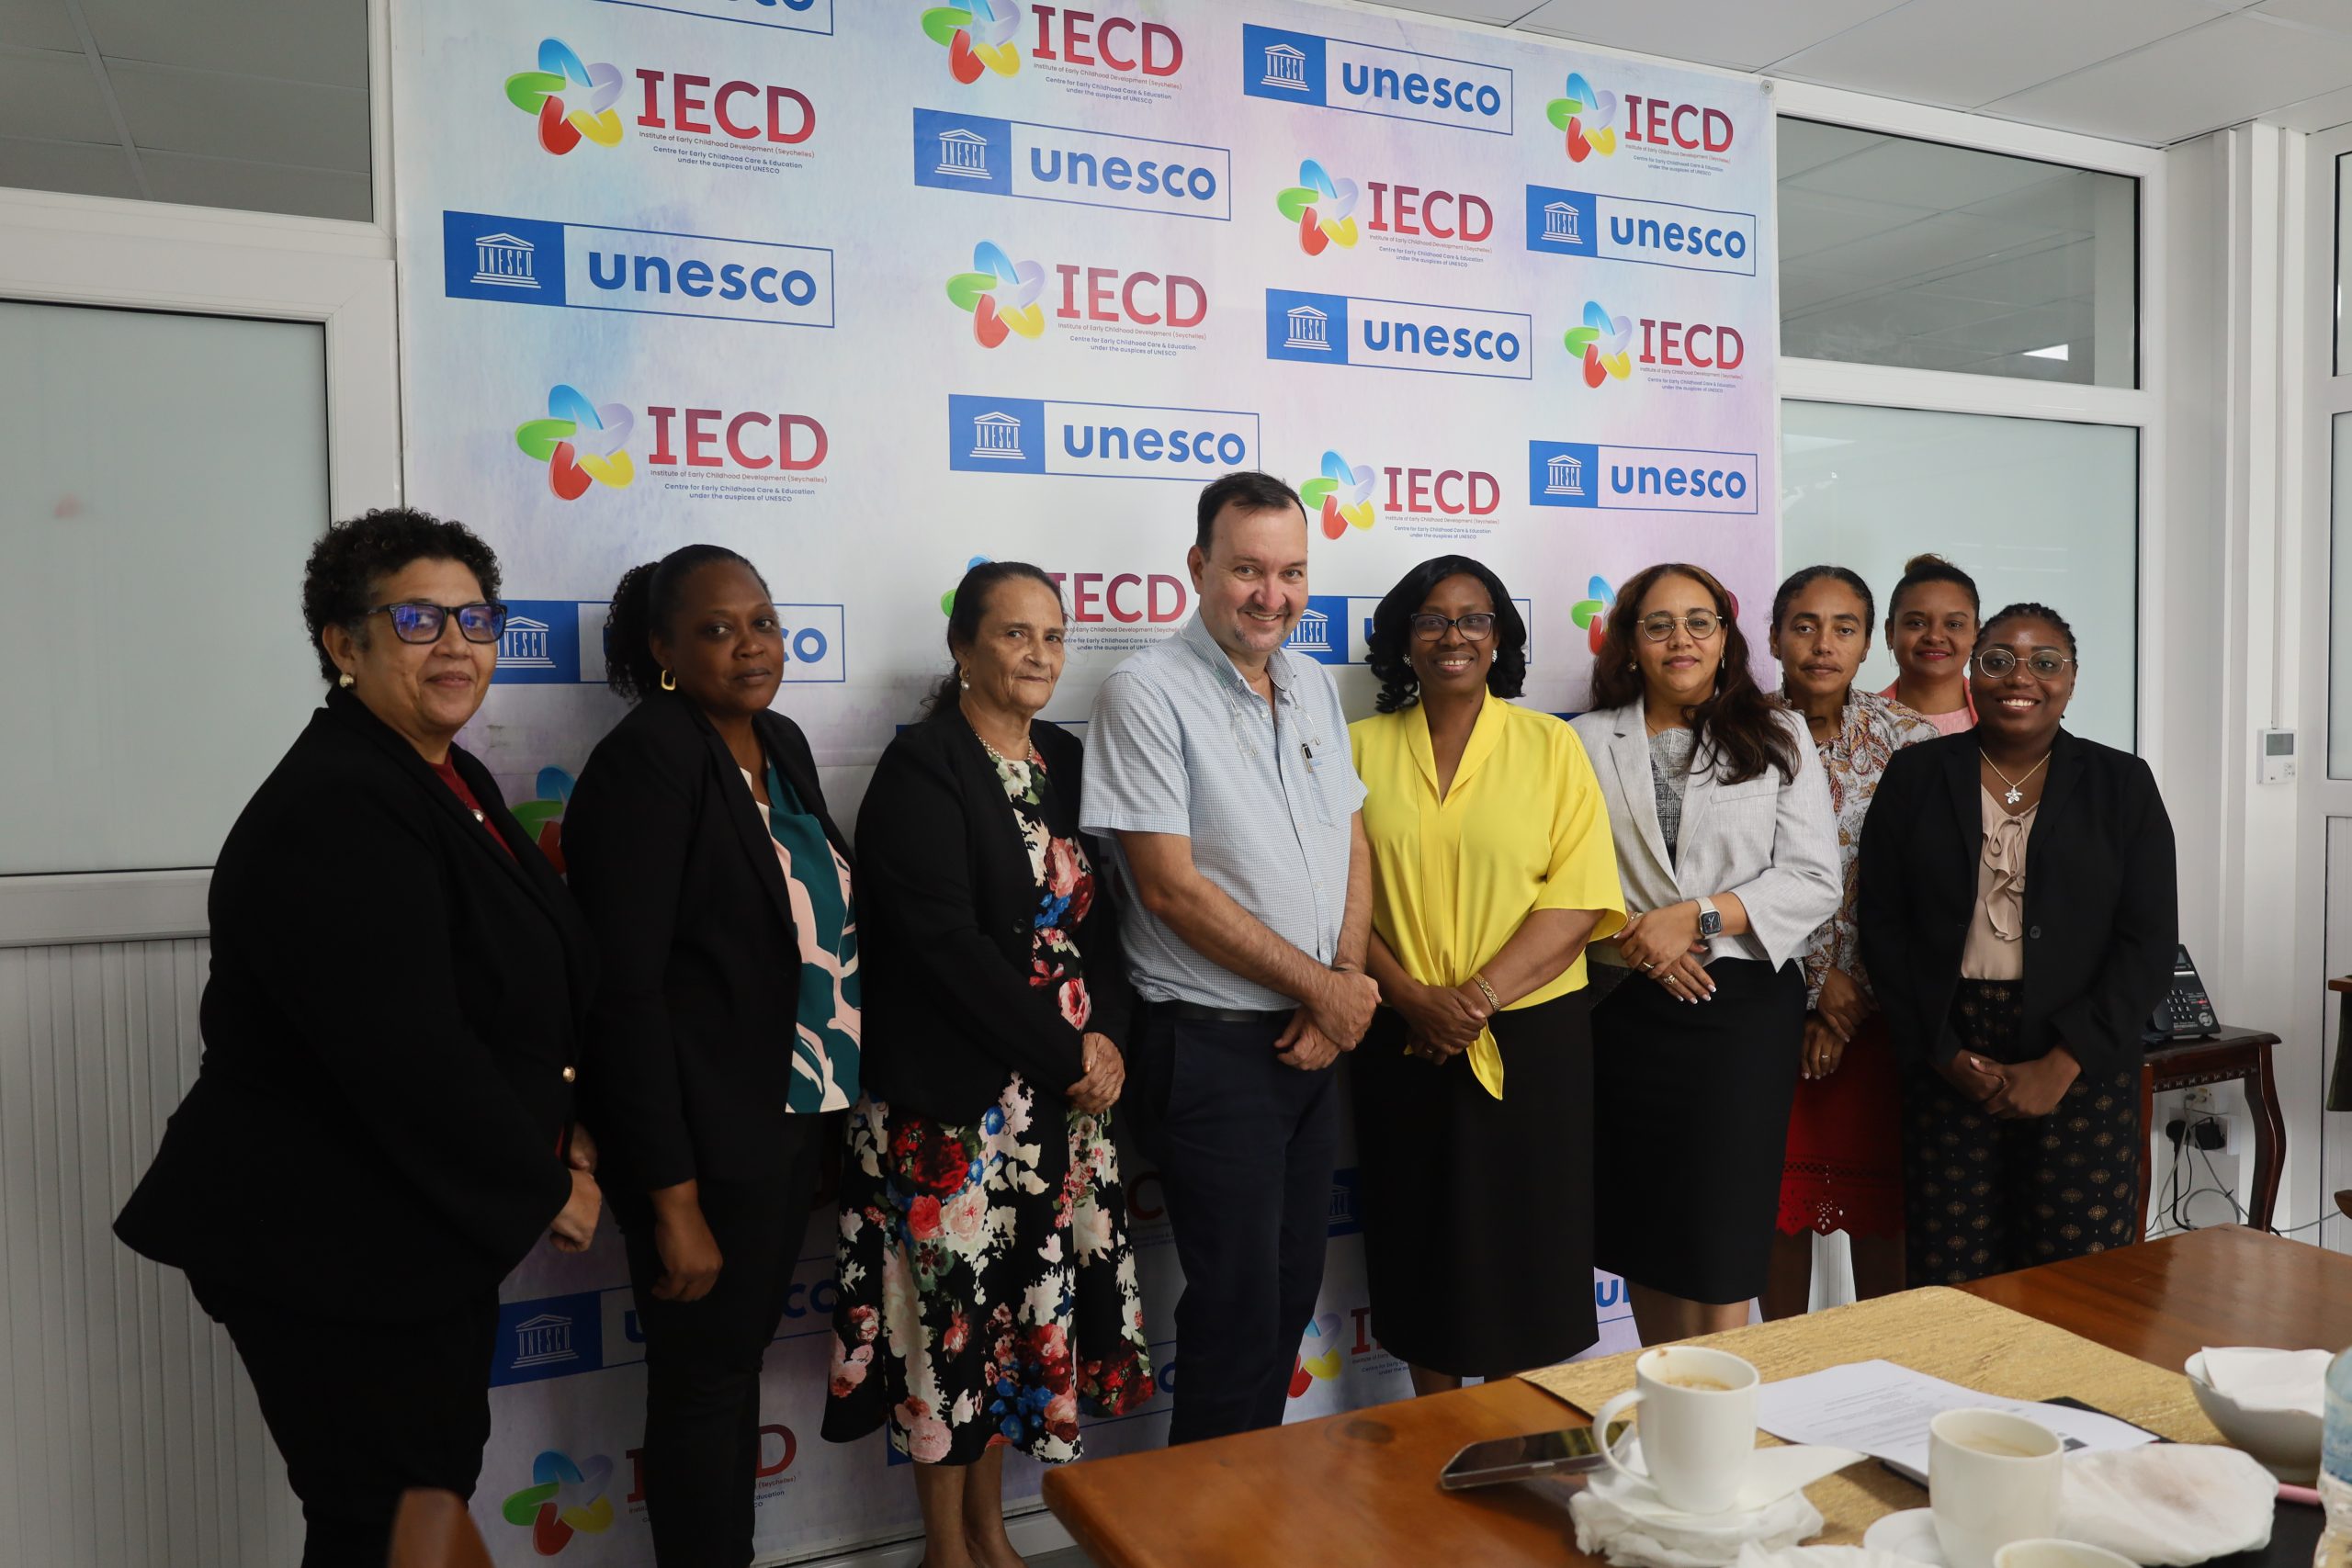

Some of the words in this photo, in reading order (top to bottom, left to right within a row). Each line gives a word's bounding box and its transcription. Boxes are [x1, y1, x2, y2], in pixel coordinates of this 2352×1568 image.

[1032, 4, 1183, 76] IECD
[1080, 70, 1109, 79] Childhood
[1110, 74, 1147, 85] Development
[1267, 54, 1304, 82] UNESCO
[1046, 76, 1066, 85] Centre
[1076, 81, 1091, 89] Early
[1091, 84, 1122, 93] Childhood
[1143, 91, 1172, 99] Education
[1129, 96, 1152, 105] UNESCO
[1343, 62, 1500, 116] unesco
[636, 68, 815, 143] IECD
[1625, 95, 1735, 151] IECD
[639, 131, 667, 140] Institute
[676, 136, 693, 144] Early
[695, 139, 728, 147] Childhood
[729, 142, 774, 152] Development
[943, 141, 985, 169] UNESCO
[689, 151, 706, 159] Early
[708, 152, 743, 162] Childhood
[769, 160, 802, 168] Education
[713, 162, 742, 170] auspices
[1031, 147, 1216, 200] unesco
[1368, 182, 1493, 242] IECD
[1546, 211, 1578, 236] UNESCO
[1611, 217, 1746, 259] unesco
[480, 246, 533, 277] UNESCO
[589, 252, 816, 306] unesco
[1057, 265, 1207, 328] IECD
[1135, 329, 1171, 337] Development
[1290, 317, 1326, 342] UNESCO
[1364, 320, 1520, 362] unesco
[1639, 319, 1744, 369] IECD
[648, 406, 828, 470] IECD
[976, 425, 1019, 450] UNESCO
[1064, 424, 1245, 465] unesco
[742, 474, 786, 482] Development
[1384, 467, 1499, 514] IECD
[1549, 466, 1580, 487] UNESCO
[1612, 466, 1746, 499] unesco
[518, 1325, 570, 1356] UNESCO
